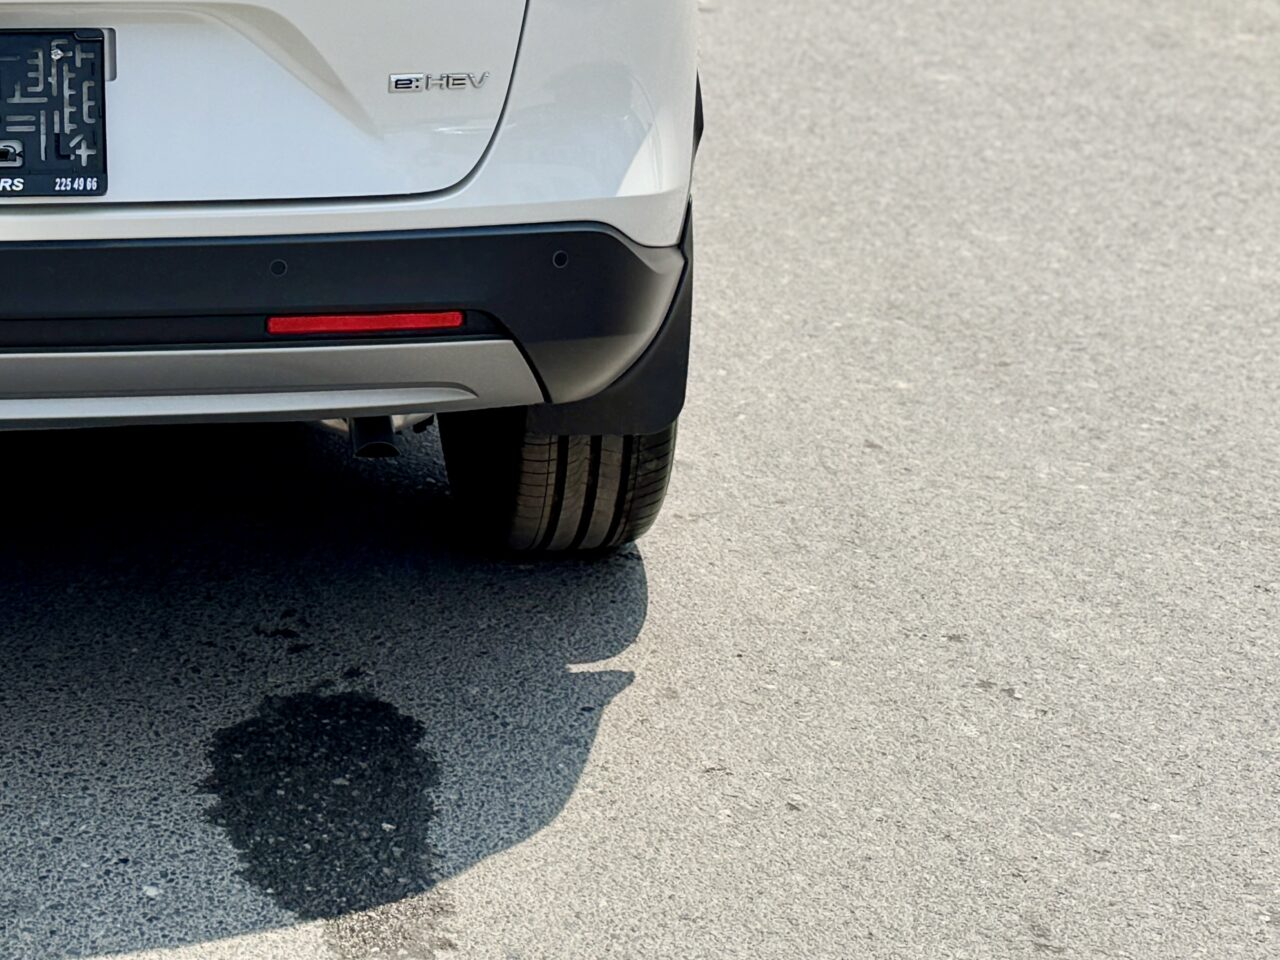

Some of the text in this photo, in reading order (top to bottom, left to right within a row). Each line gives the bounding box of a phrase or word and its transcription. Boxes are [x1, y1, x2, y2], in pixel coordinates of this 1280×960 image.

[54, 177, 98, 190] 225 49 66
